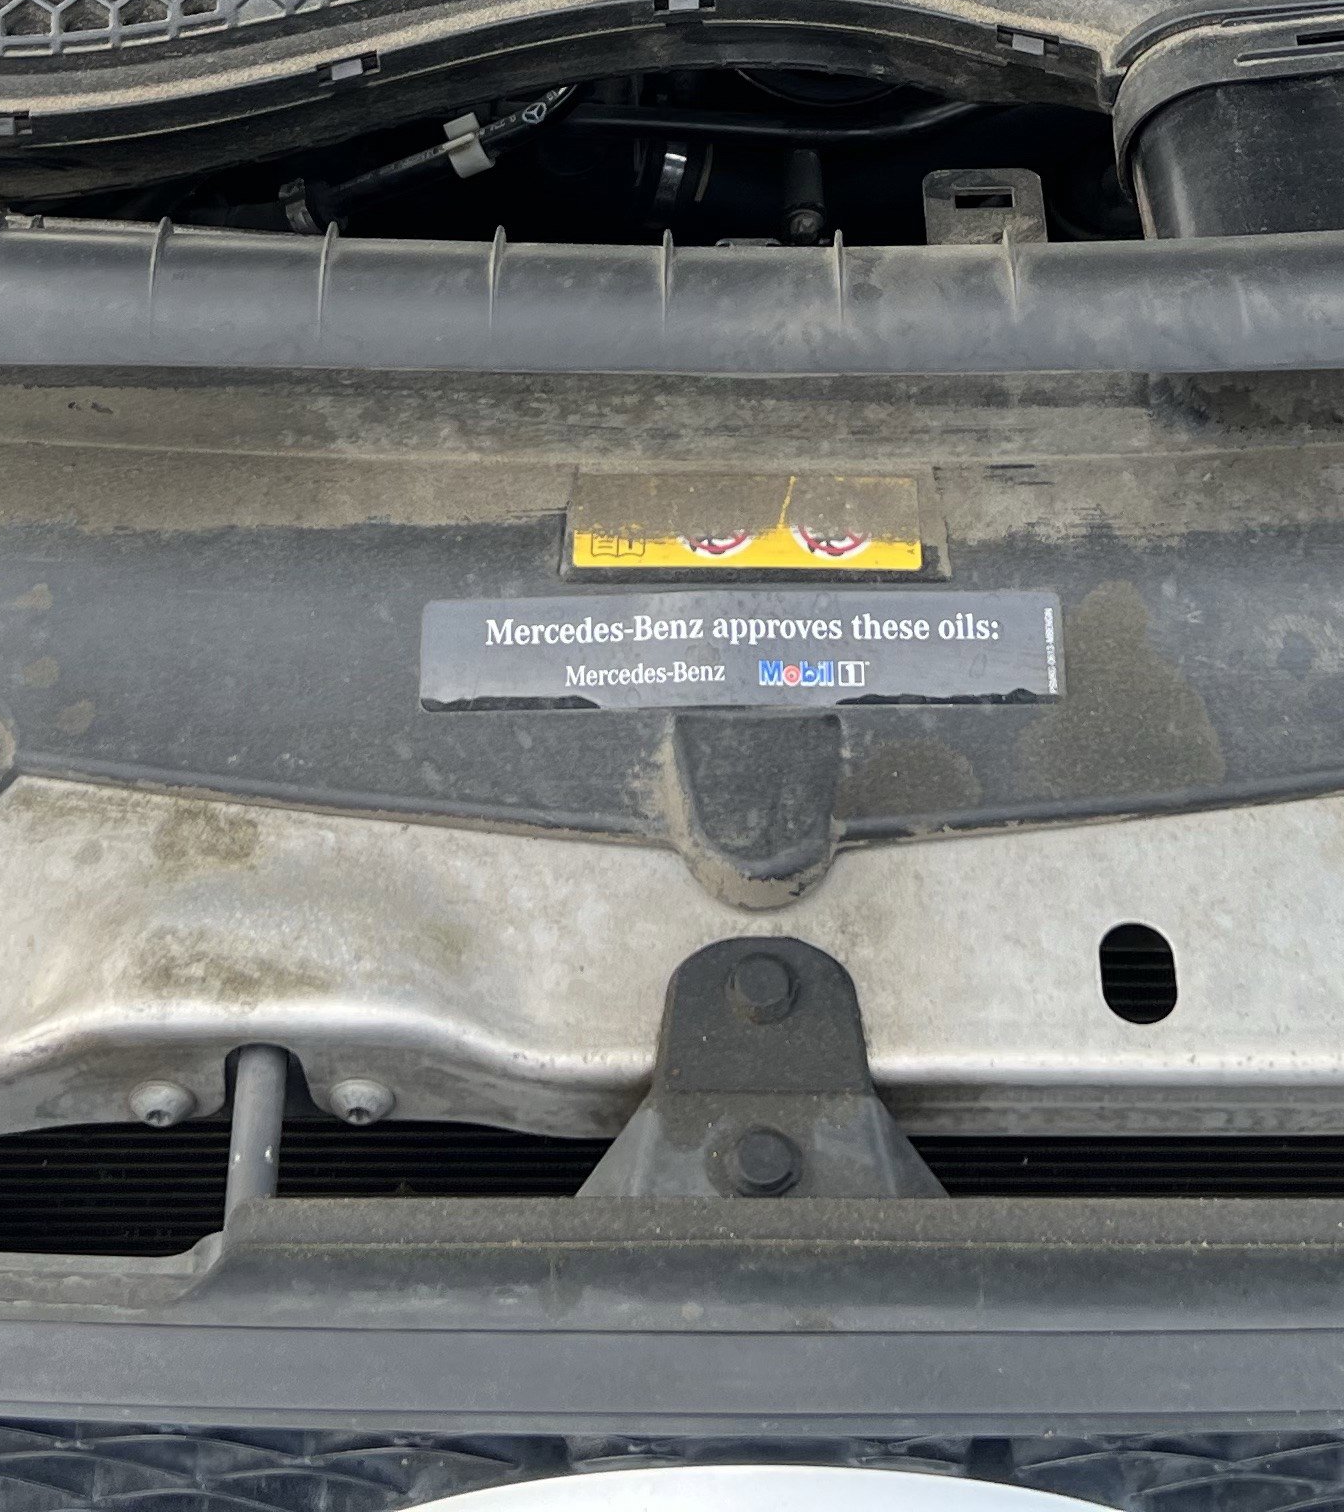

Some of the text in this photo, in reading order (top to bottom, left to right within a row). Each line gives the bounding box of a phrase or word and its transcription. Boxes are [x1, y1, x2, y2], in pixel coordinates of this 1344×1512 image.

[485, 612, 1000, 646] Mercedes-Benz approves these oils:
[564, 660, 726, 687] Mercedes-Benz
[758, 659, 835, 687] Mobil
